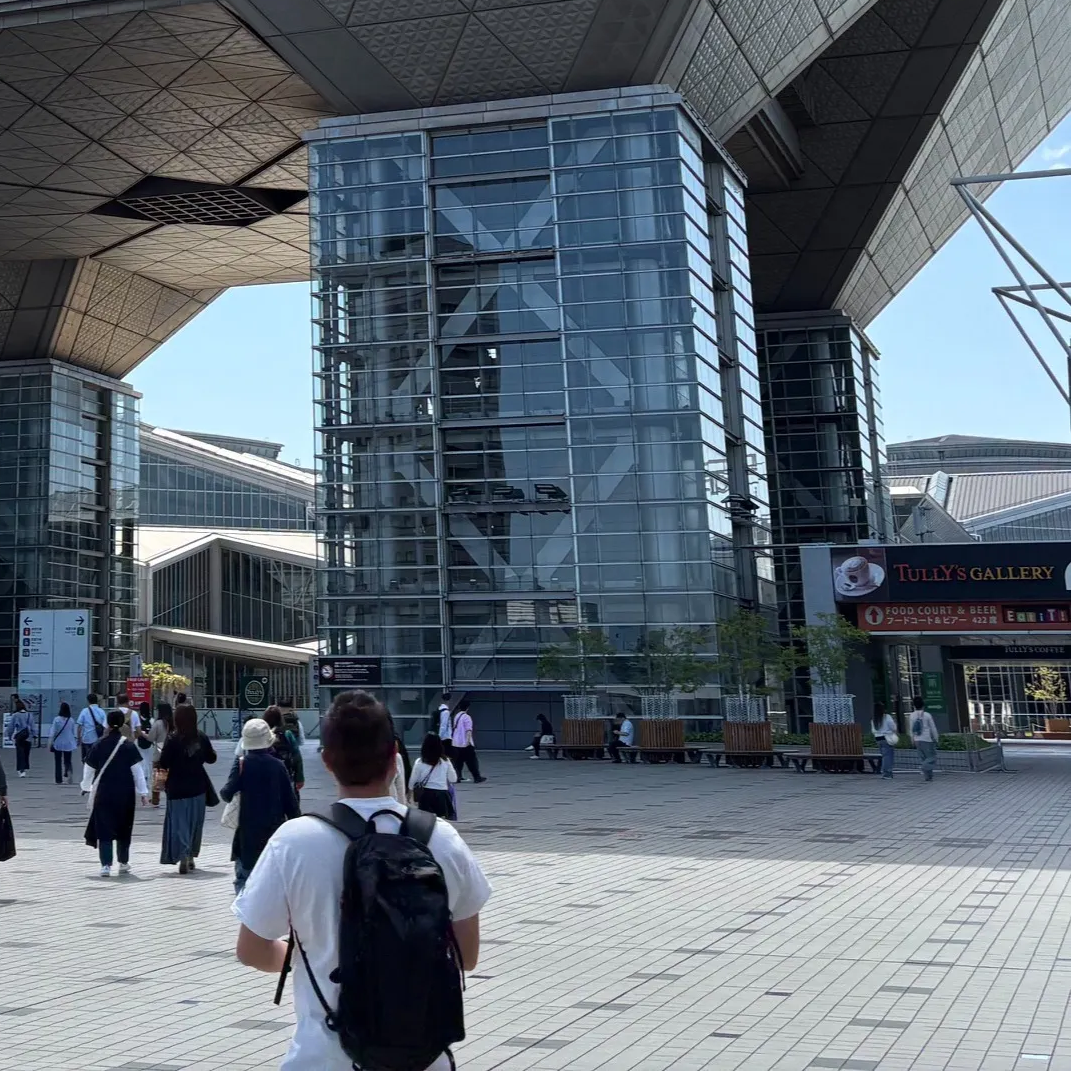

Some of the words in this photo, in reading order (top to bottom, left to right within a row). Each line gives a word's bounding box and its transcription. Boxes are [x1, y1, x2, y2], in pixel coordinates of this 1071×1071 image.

[893, 563, 966, 581] TULLY'S
[969, 566, 1055, 581] GALLERY
[886, 607, 914, 615] FOOD
[917, 606, 953, 615] COURT
[957, 607, 965, 615] &
[970, 605, 997, 614] BEER
